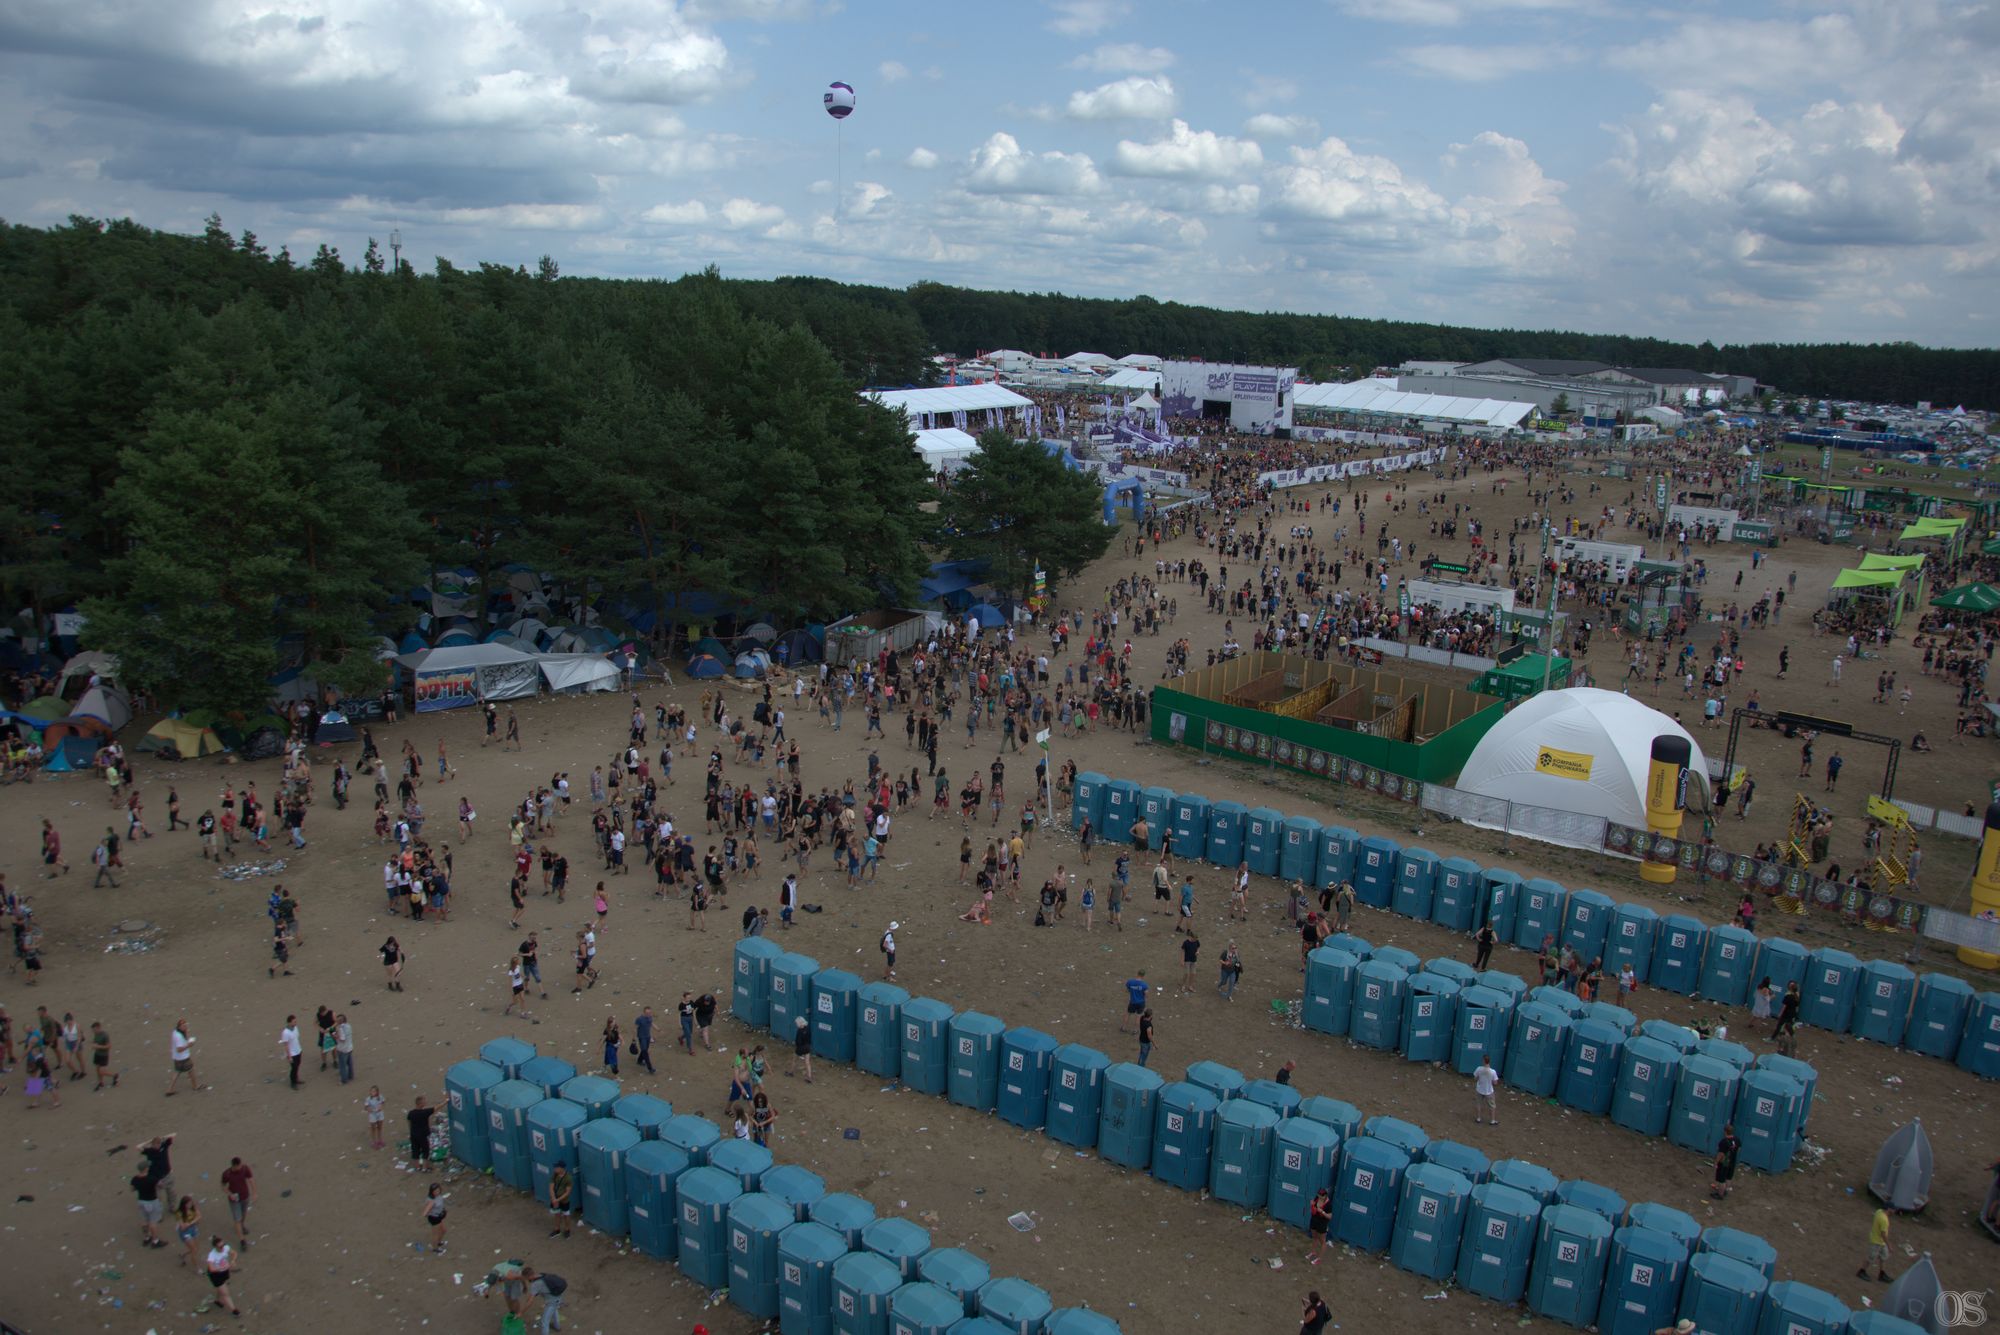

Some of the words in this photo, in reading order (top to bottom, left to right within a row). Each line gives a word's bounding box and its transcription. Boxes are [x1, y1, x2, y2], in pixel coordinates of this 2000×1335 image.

[1234, 383, 1255, 391] PLAY
[1736, 529, 1760, 539] LECH
[1505, 620, 1540, 639] LCH
